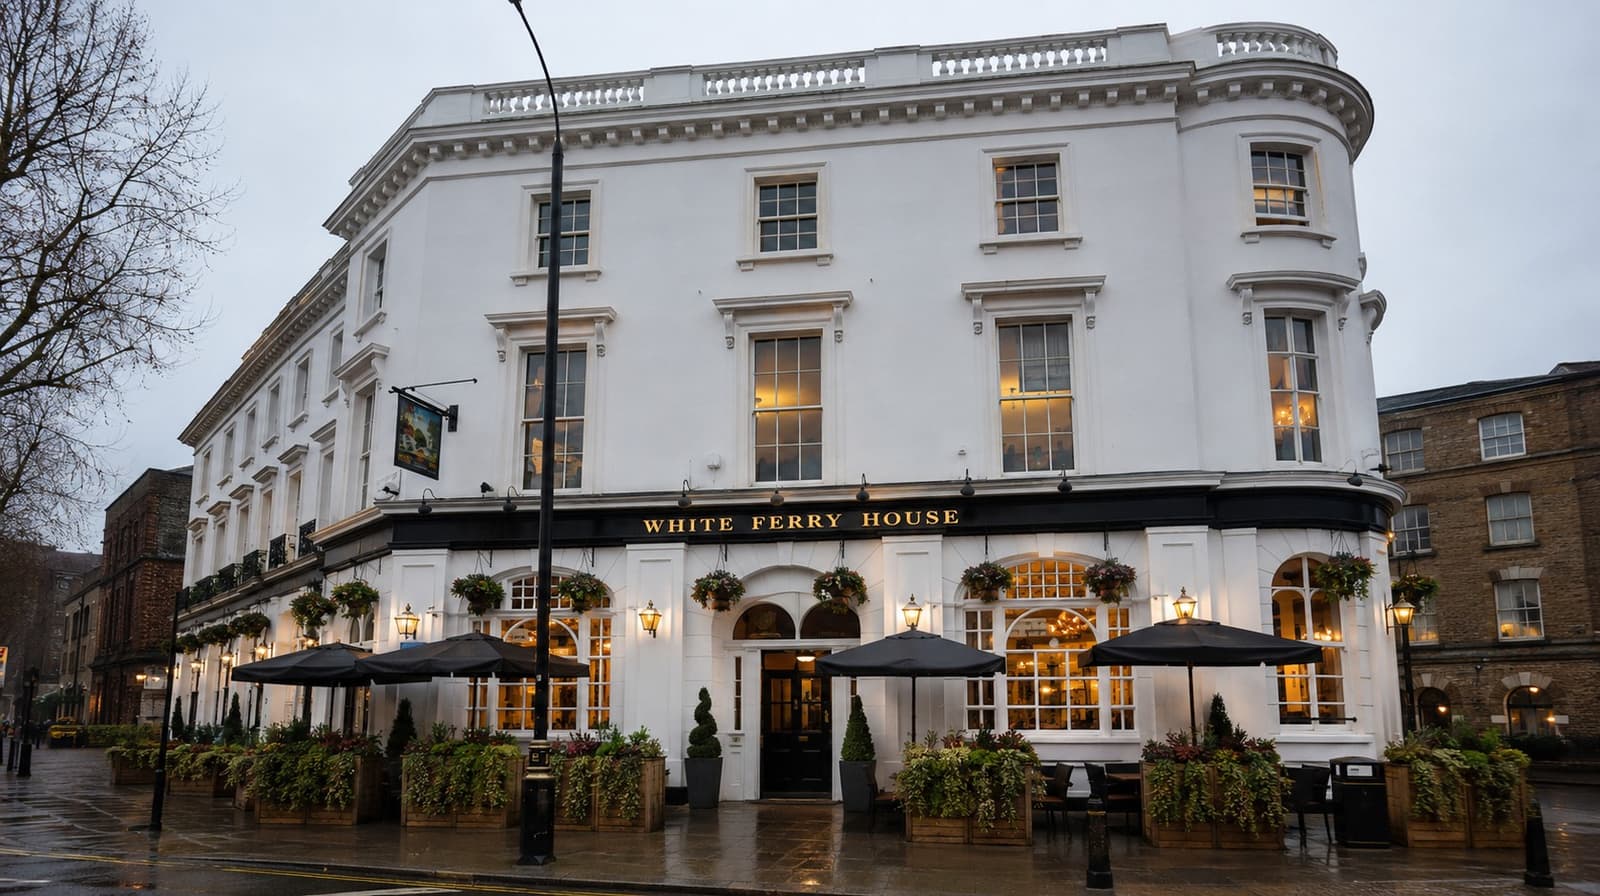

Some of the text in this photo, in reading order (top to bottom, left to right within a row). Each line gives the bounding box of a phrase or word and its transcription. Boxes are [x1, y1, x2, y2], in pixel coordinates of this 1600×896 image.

[643, 509, 959, 533] WHITE FERRY HOUSE
